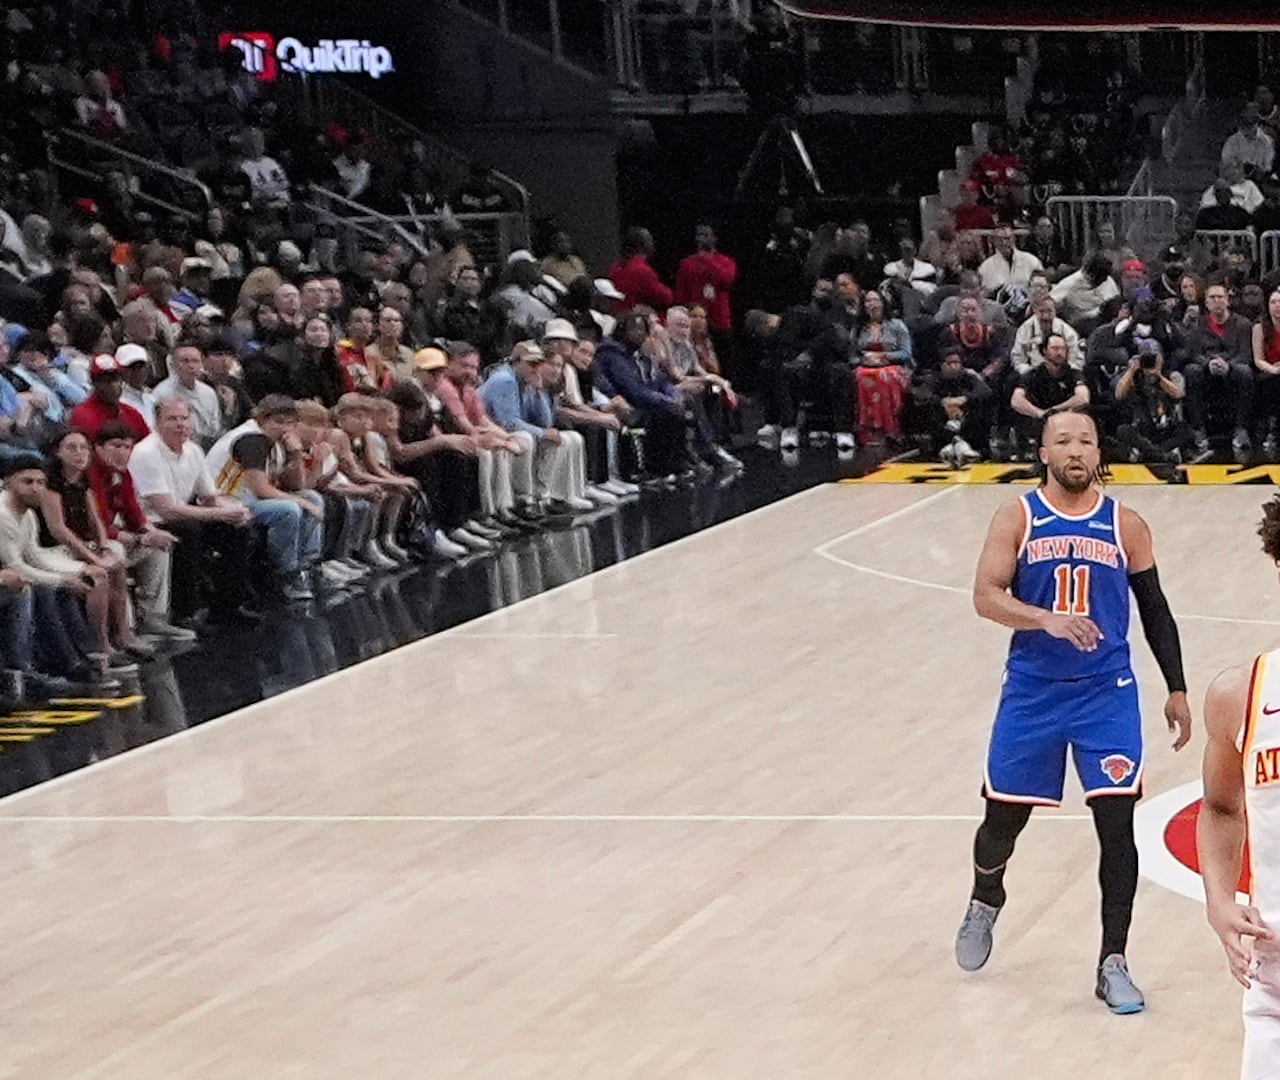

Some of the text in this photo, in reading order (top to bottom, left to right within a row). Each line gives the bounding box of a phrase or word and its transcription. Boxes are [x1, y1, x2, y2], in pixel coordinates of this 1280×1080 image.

[1027, 535, 1119, 569] NEW YORK
[1052, 563, 1090, 616] 11
